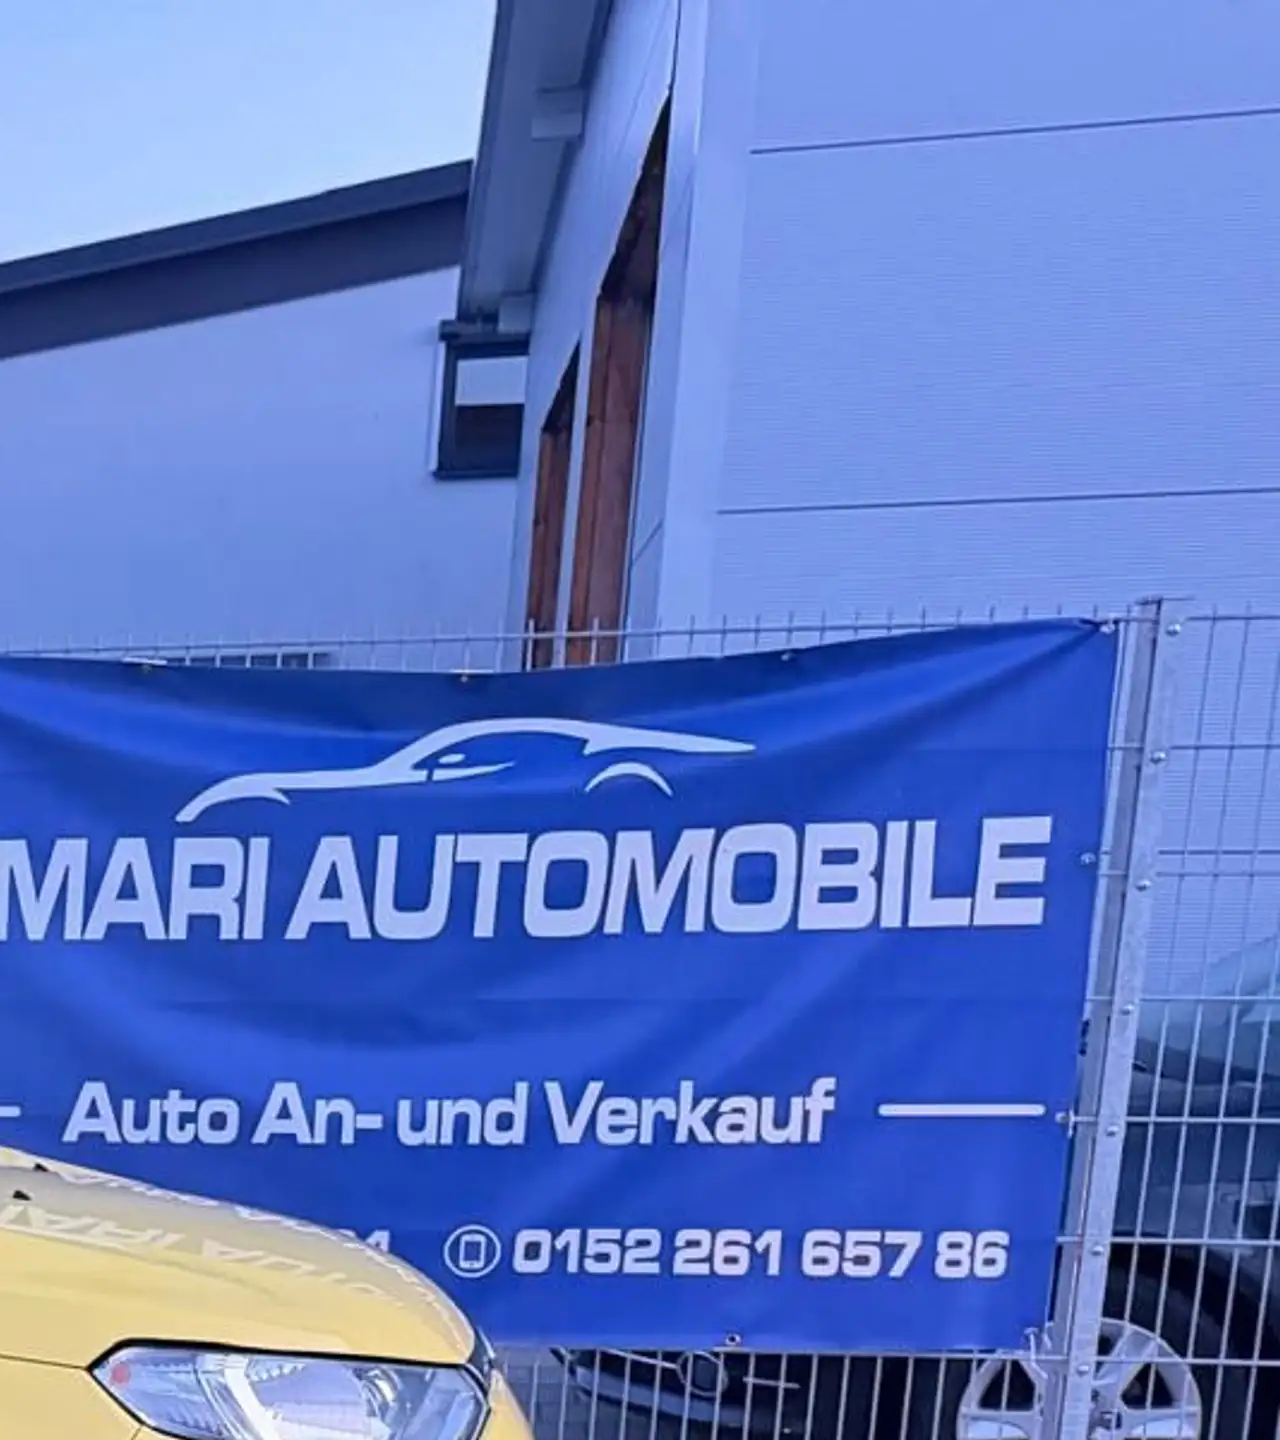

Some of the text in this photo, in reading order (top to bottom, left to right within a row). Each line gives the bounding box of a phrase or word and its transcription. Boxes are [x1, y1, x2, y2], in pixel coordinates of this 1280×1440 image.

[285, 815, 1052, 940] AUTOMOBILE
[62, 1075, 836, 1146] Auto An- und Verkauf
[513, 1227, 1010, 1280] 0152 261 657 86
